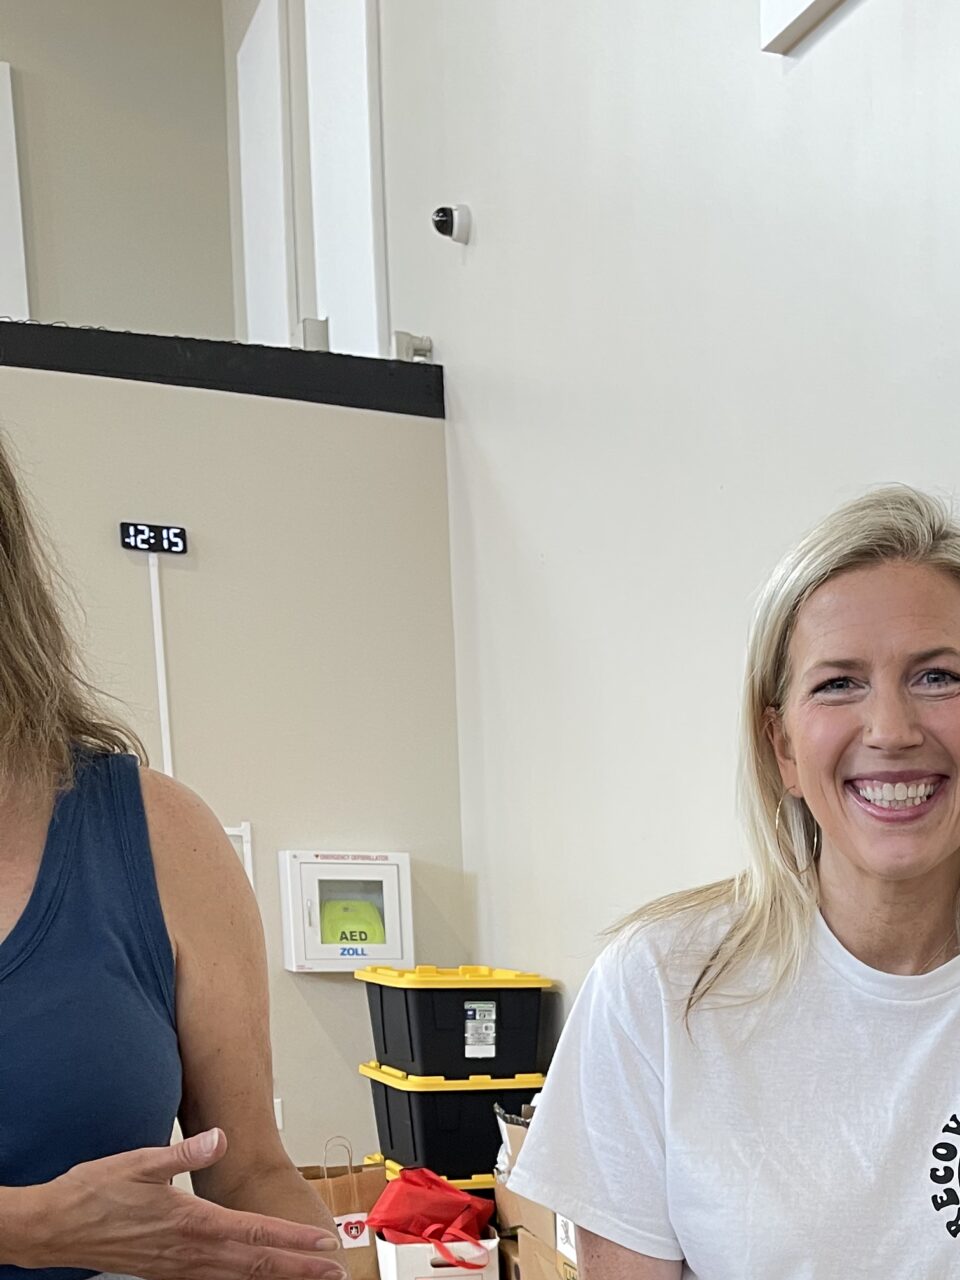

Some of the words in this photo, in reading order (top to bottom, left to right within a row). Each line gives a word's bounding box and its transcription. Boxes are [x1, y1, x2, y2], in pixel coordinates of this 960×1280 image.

[124, 525, 184, 552] 12:15
[340, 931, 368, 942] AED
[340, 948, 367, 956] ZOLL
